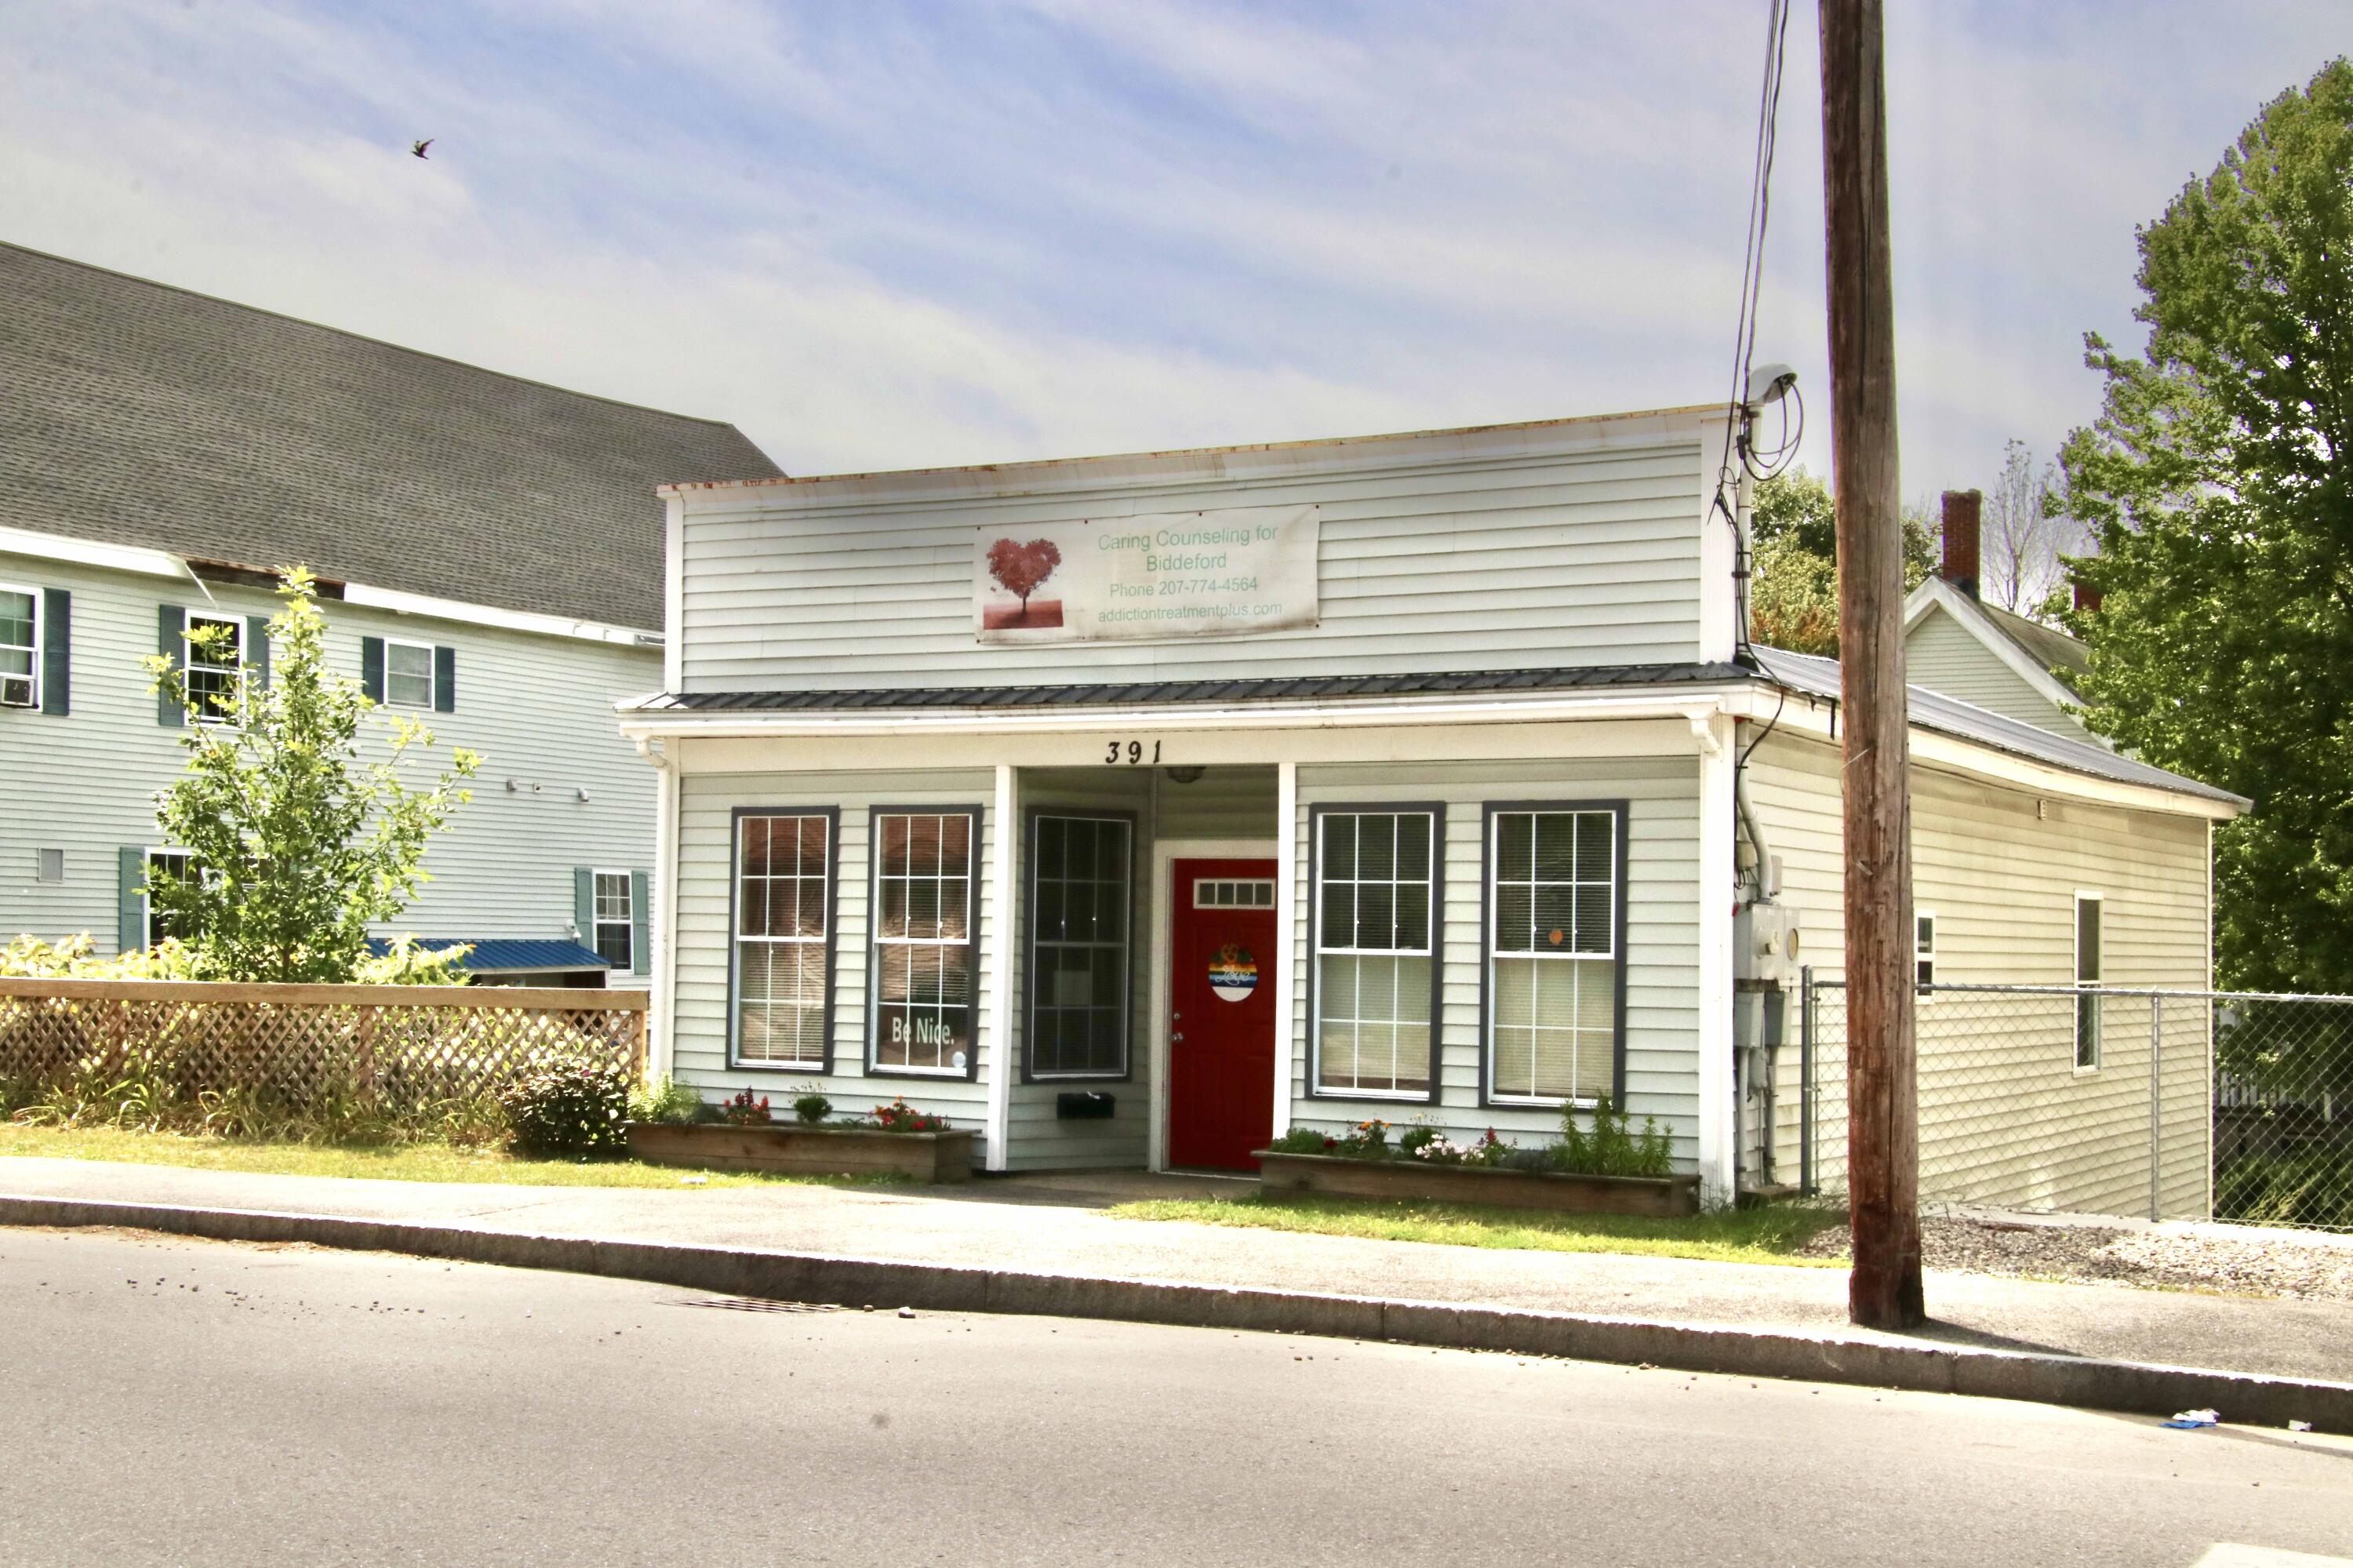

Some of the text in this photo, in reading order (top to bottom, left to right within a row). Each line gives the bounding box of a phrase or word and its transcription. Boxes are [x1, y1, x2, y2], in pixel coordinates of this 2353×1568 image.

[1098, 525, 1278, 551] Caring Counseling for
[1147, 552, 1227, 572] Biddeford
[1110, 577, 1259, 598] Phone 207-774-4564
[1098, 602, 1282, 623] addictiontreatmentplus.com
[1105, 740, 1161, 764] 391
[892, 1017, 911, 1043] Be
